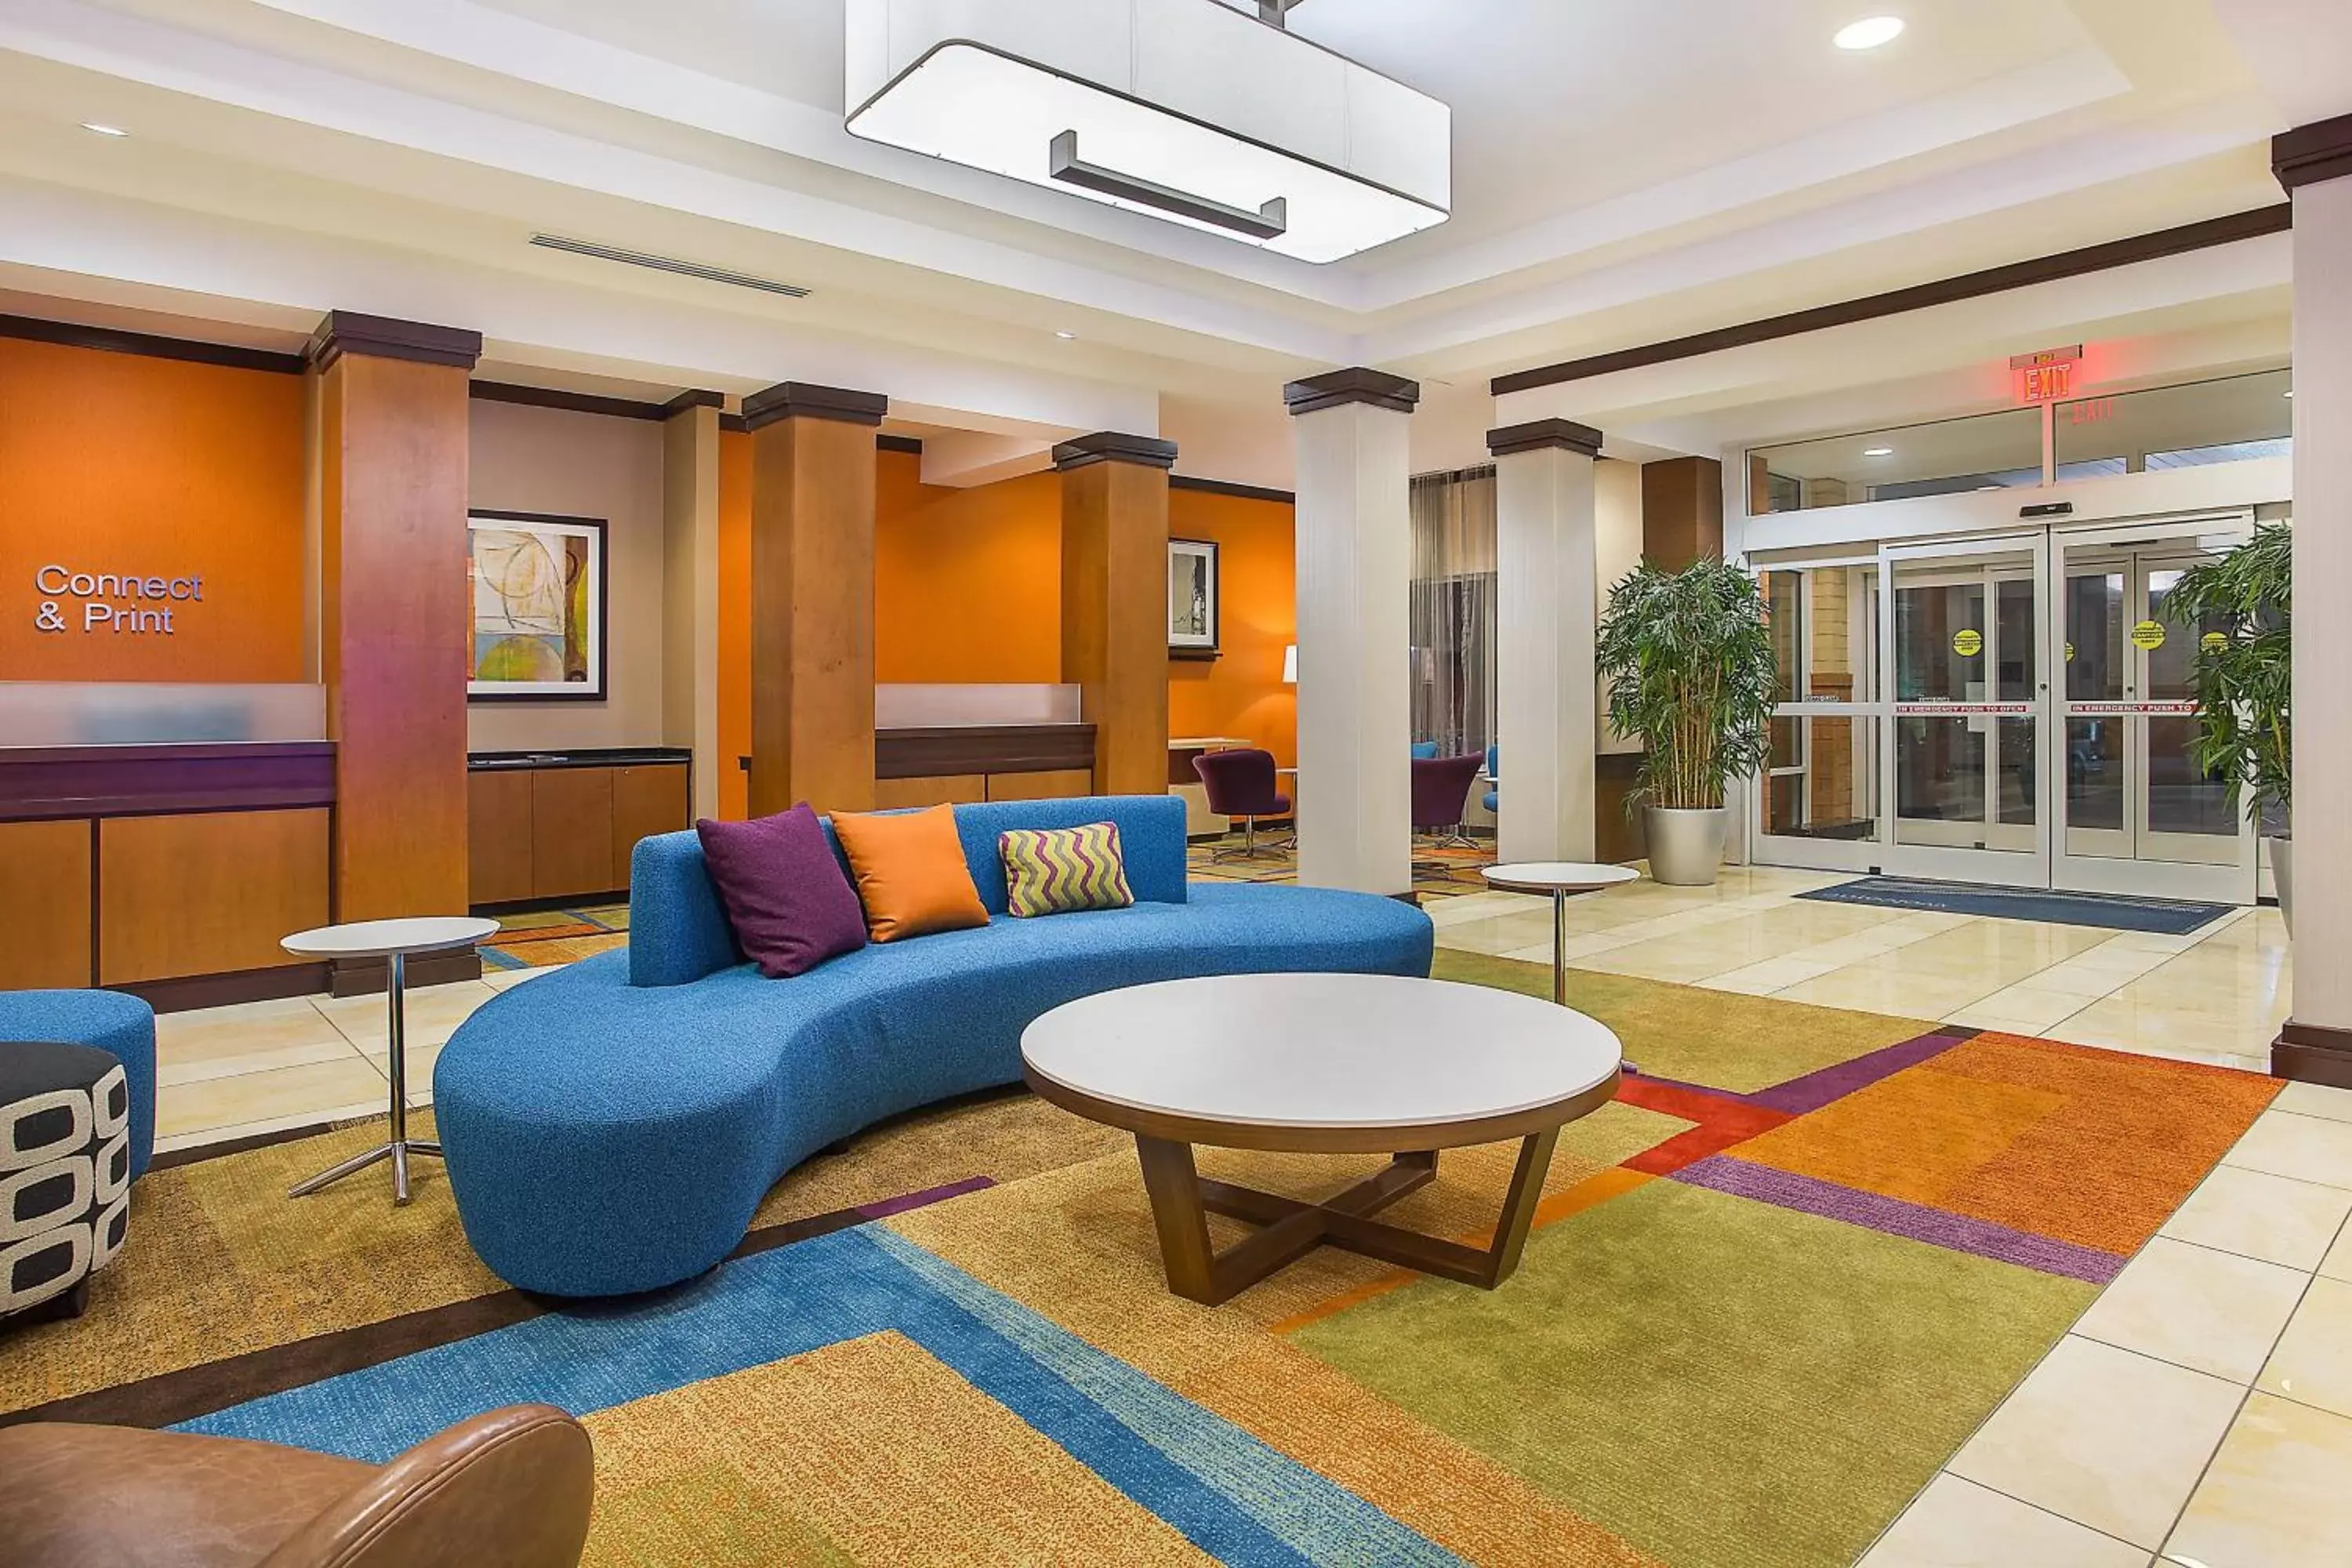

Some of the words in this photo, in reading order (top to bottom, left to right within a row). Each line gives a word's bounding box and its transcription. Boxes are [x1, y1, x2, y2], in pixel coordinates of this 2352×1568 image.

[2025, 363, 2071, 401] EXIT
[36, 564, 202, 601] Connect
[35, 601, 67, 633] &
[84, 603, 173, 634] Print
